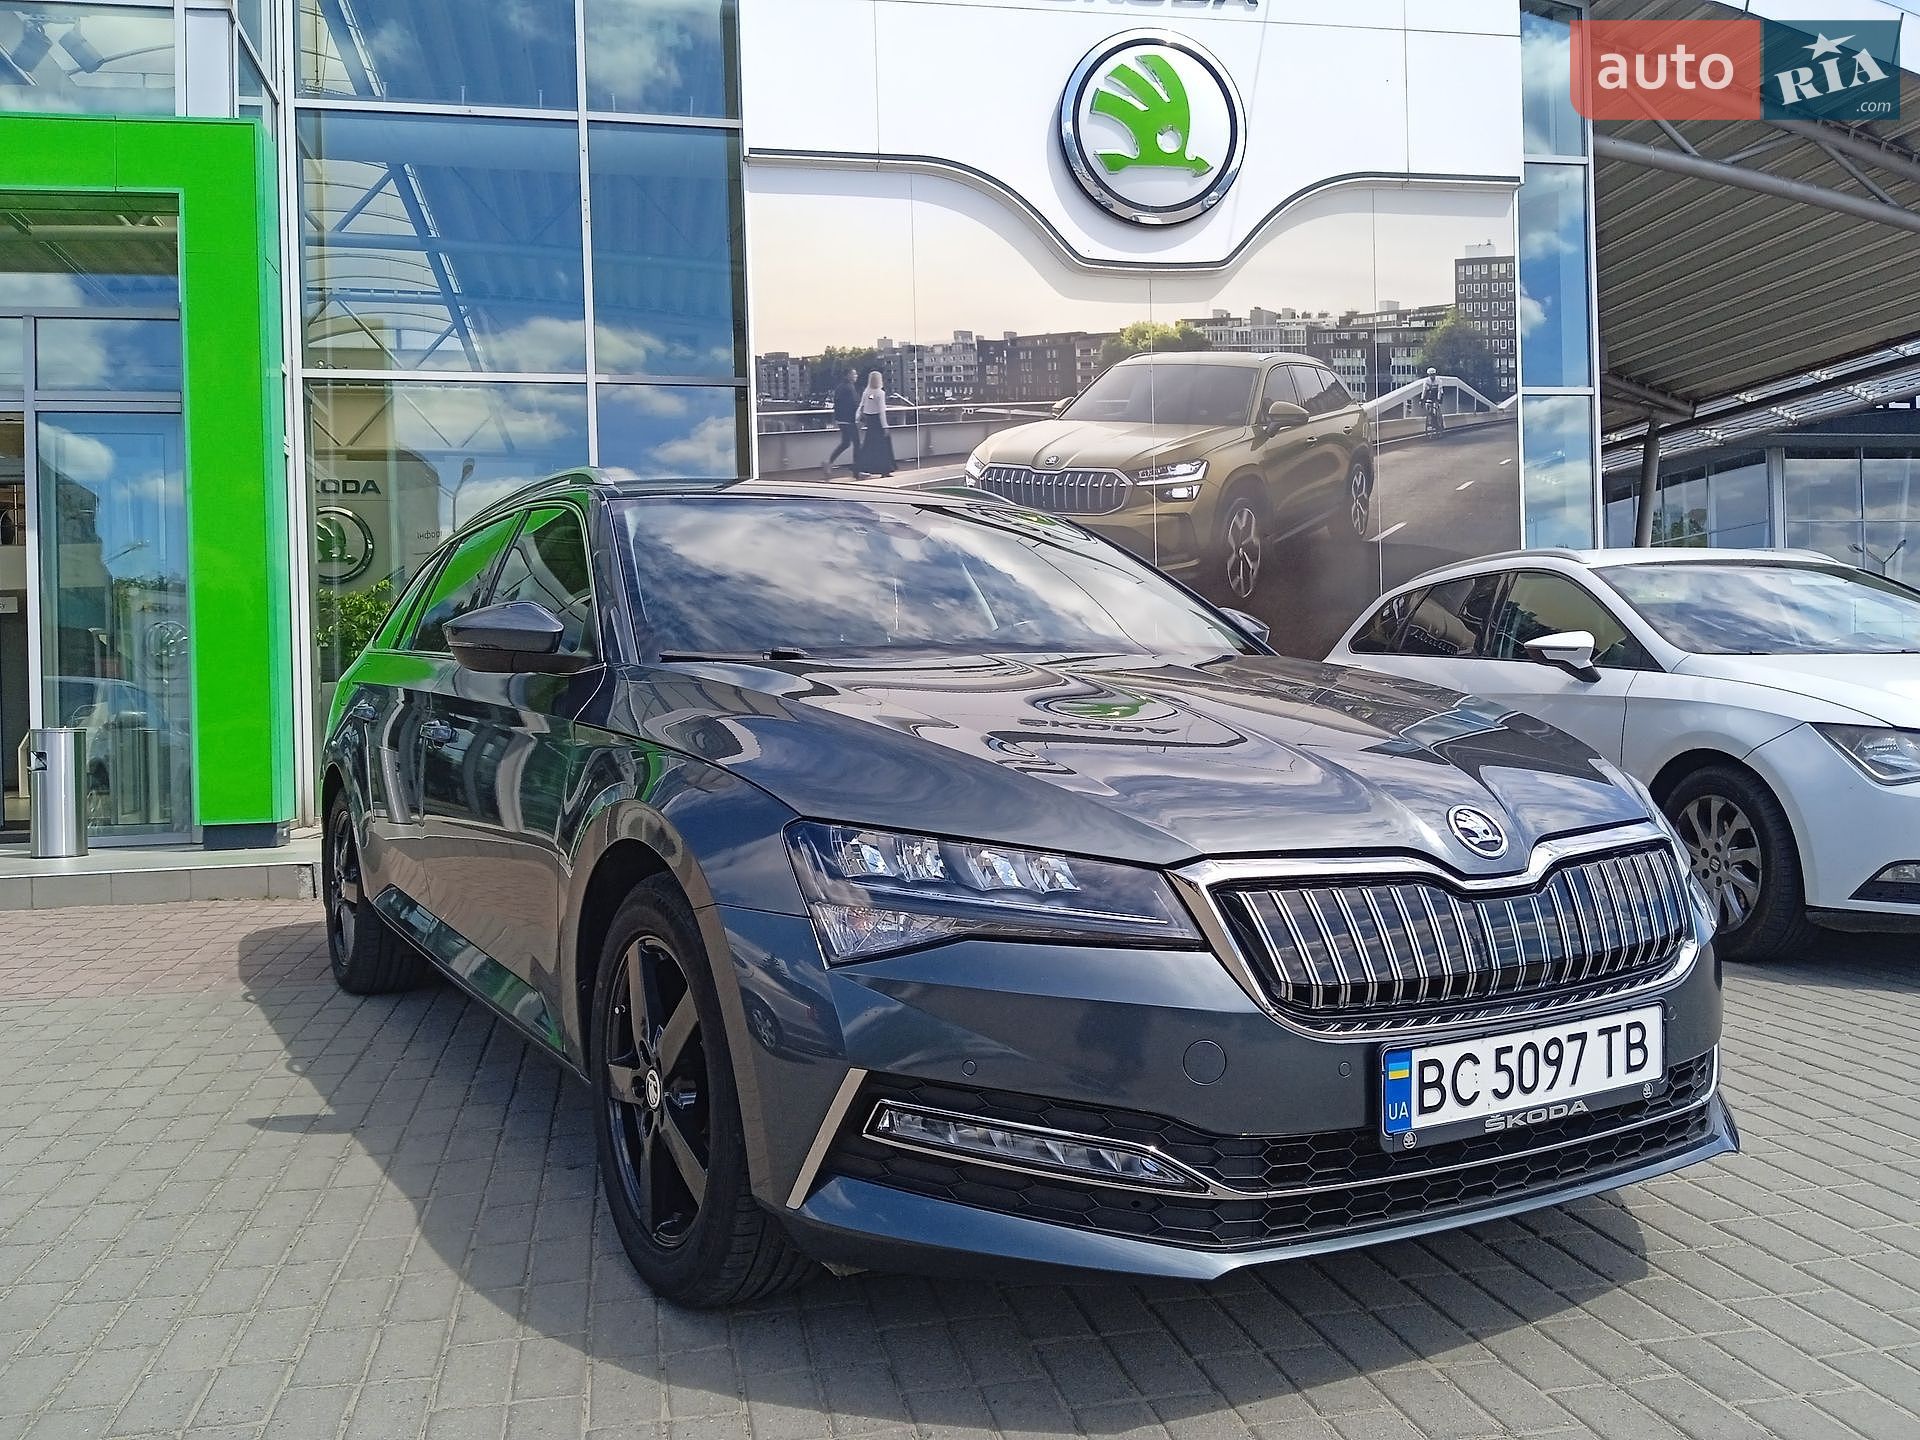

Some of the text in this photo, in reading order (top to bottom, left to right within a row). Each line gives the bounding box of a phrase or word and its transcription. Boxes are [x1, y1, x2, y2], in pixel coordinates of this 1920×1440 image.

[1415, 1020, 1650, 1116] BC 5097 TB
[1388, 1102, 1409, 1121] UA
[1484, 1099, 1589, 1133] ŠKODA
